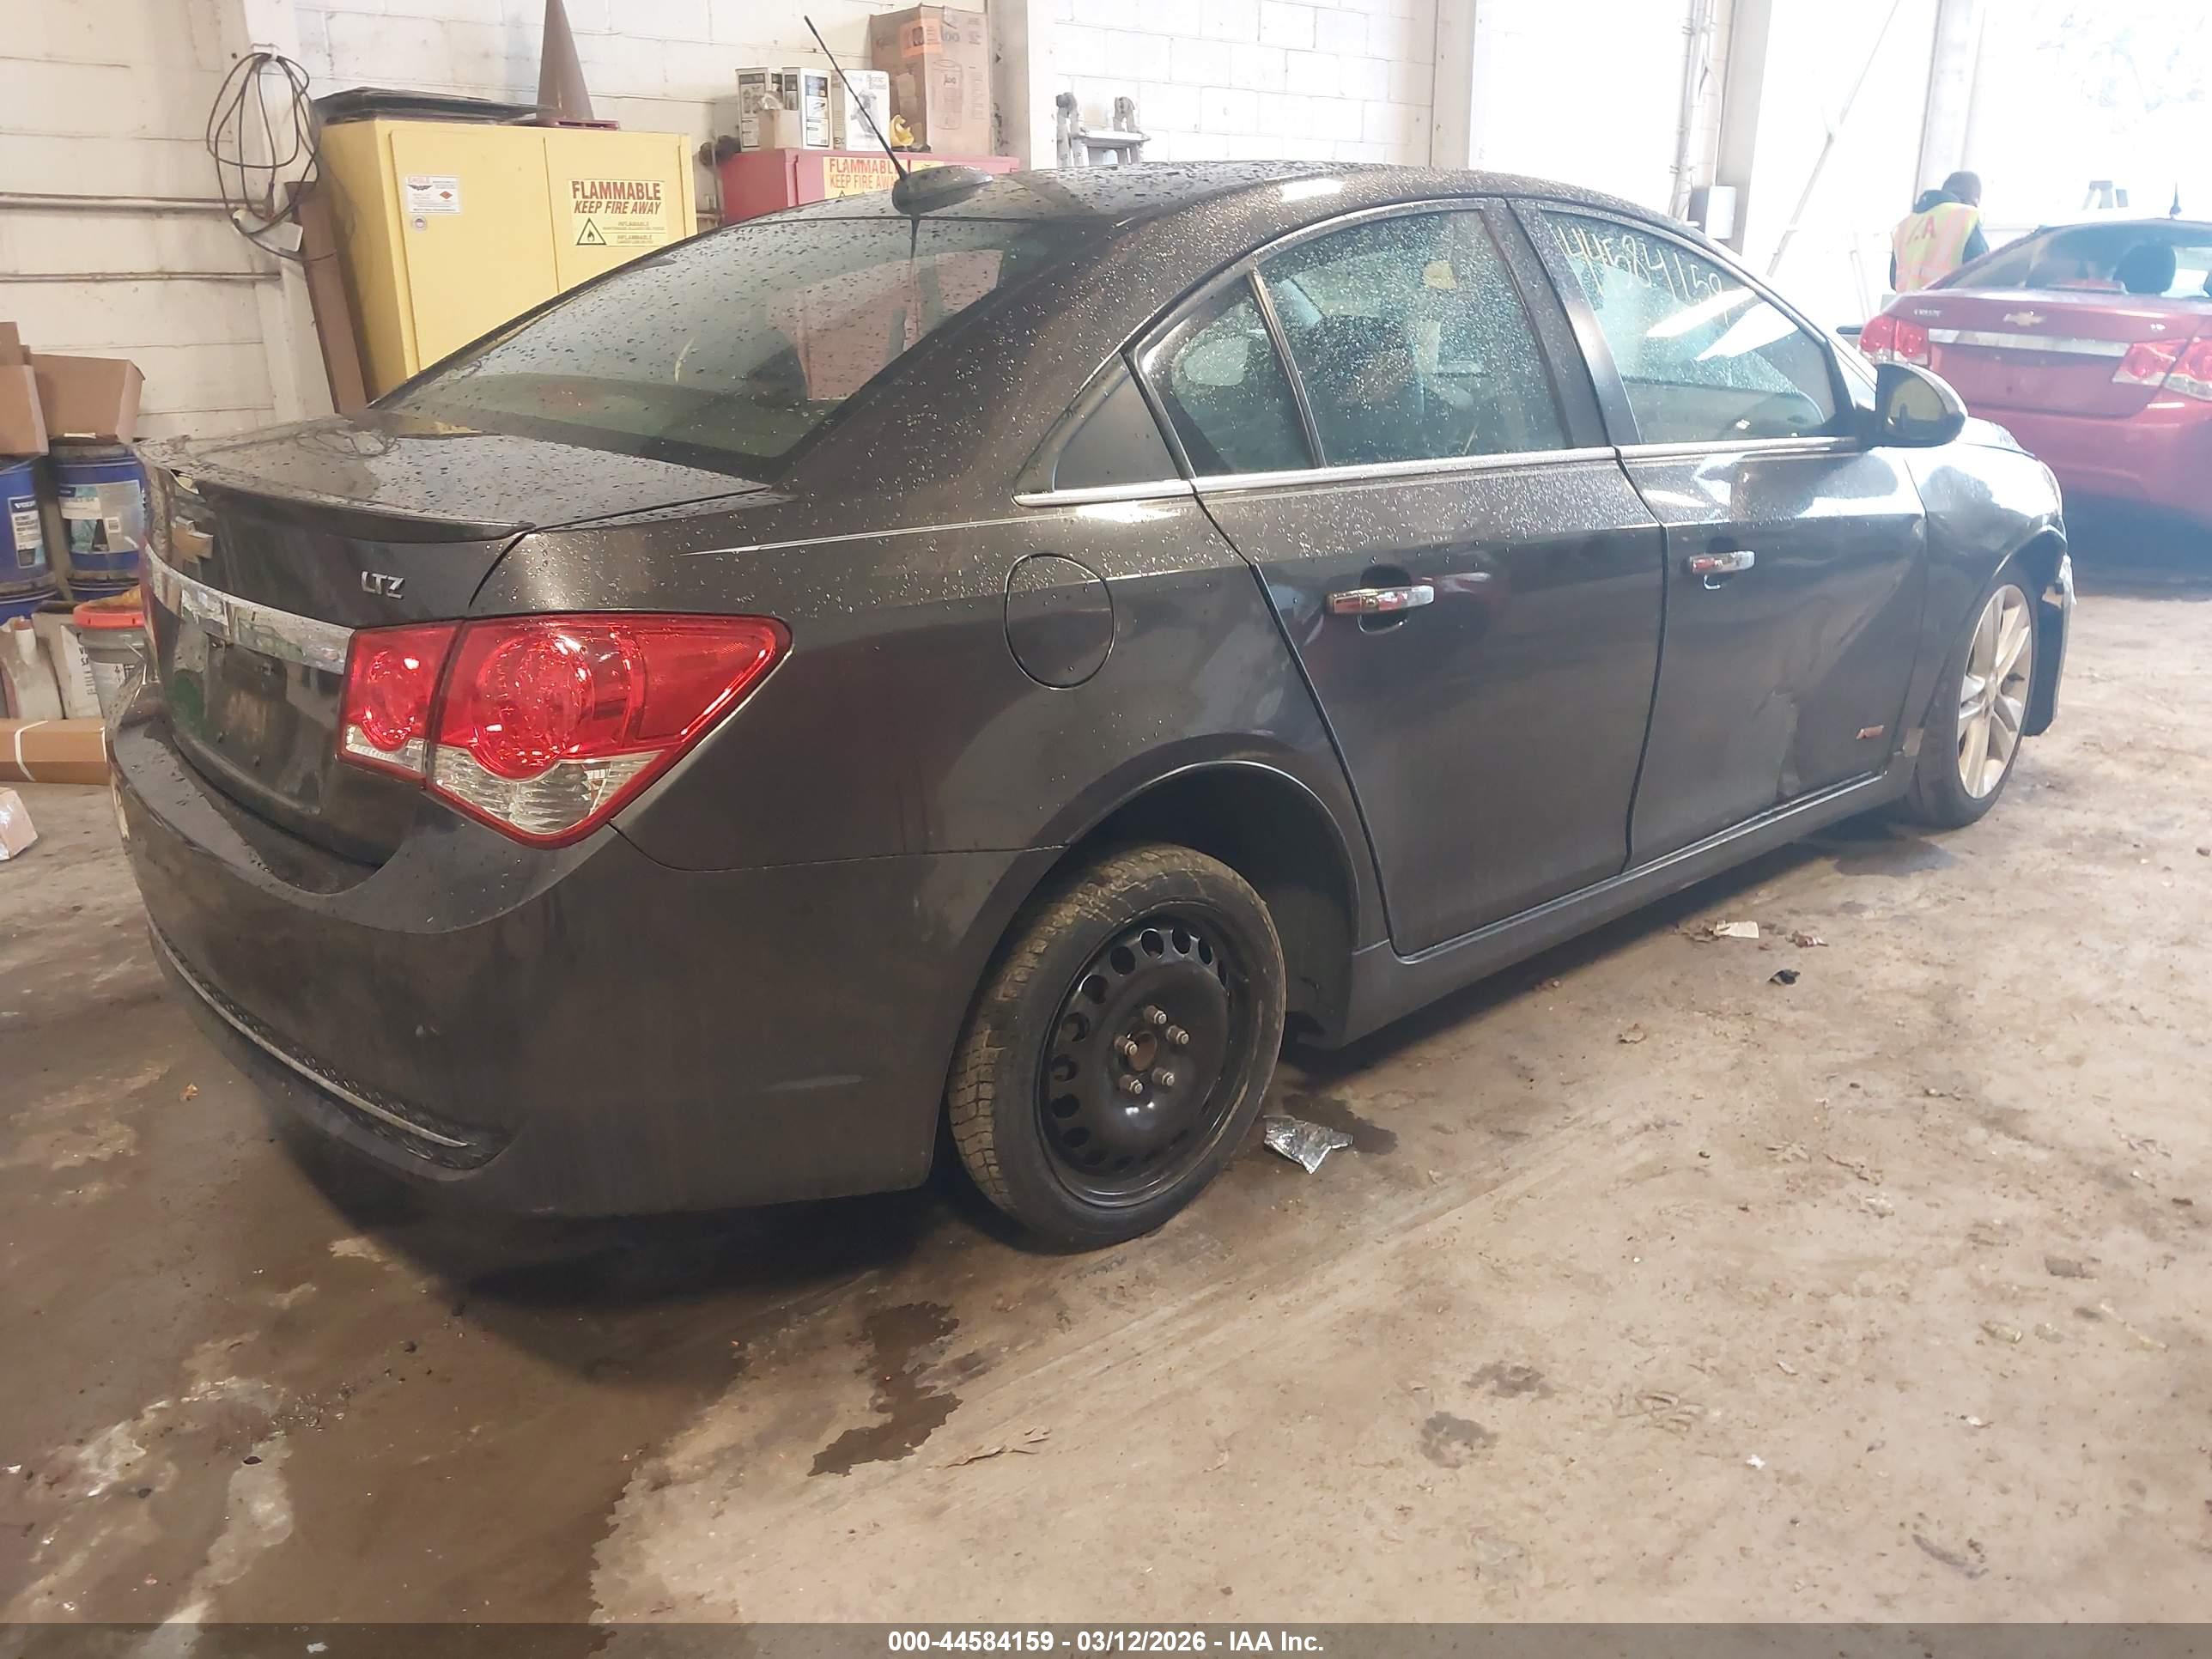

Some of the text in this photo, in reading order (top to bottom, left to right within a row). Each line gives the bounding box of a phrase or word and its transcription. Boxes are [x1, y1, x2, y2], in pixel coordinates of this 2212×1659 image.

[830, 174, 851, 188] KEEP
[854, 175, 872, 188] FIRE
[571, 181, 661, 200] FLAMMABLE
[574, 201, 661, 215] KEEP FIRE AWAY
[362, 570, 404, 599] LTZ
